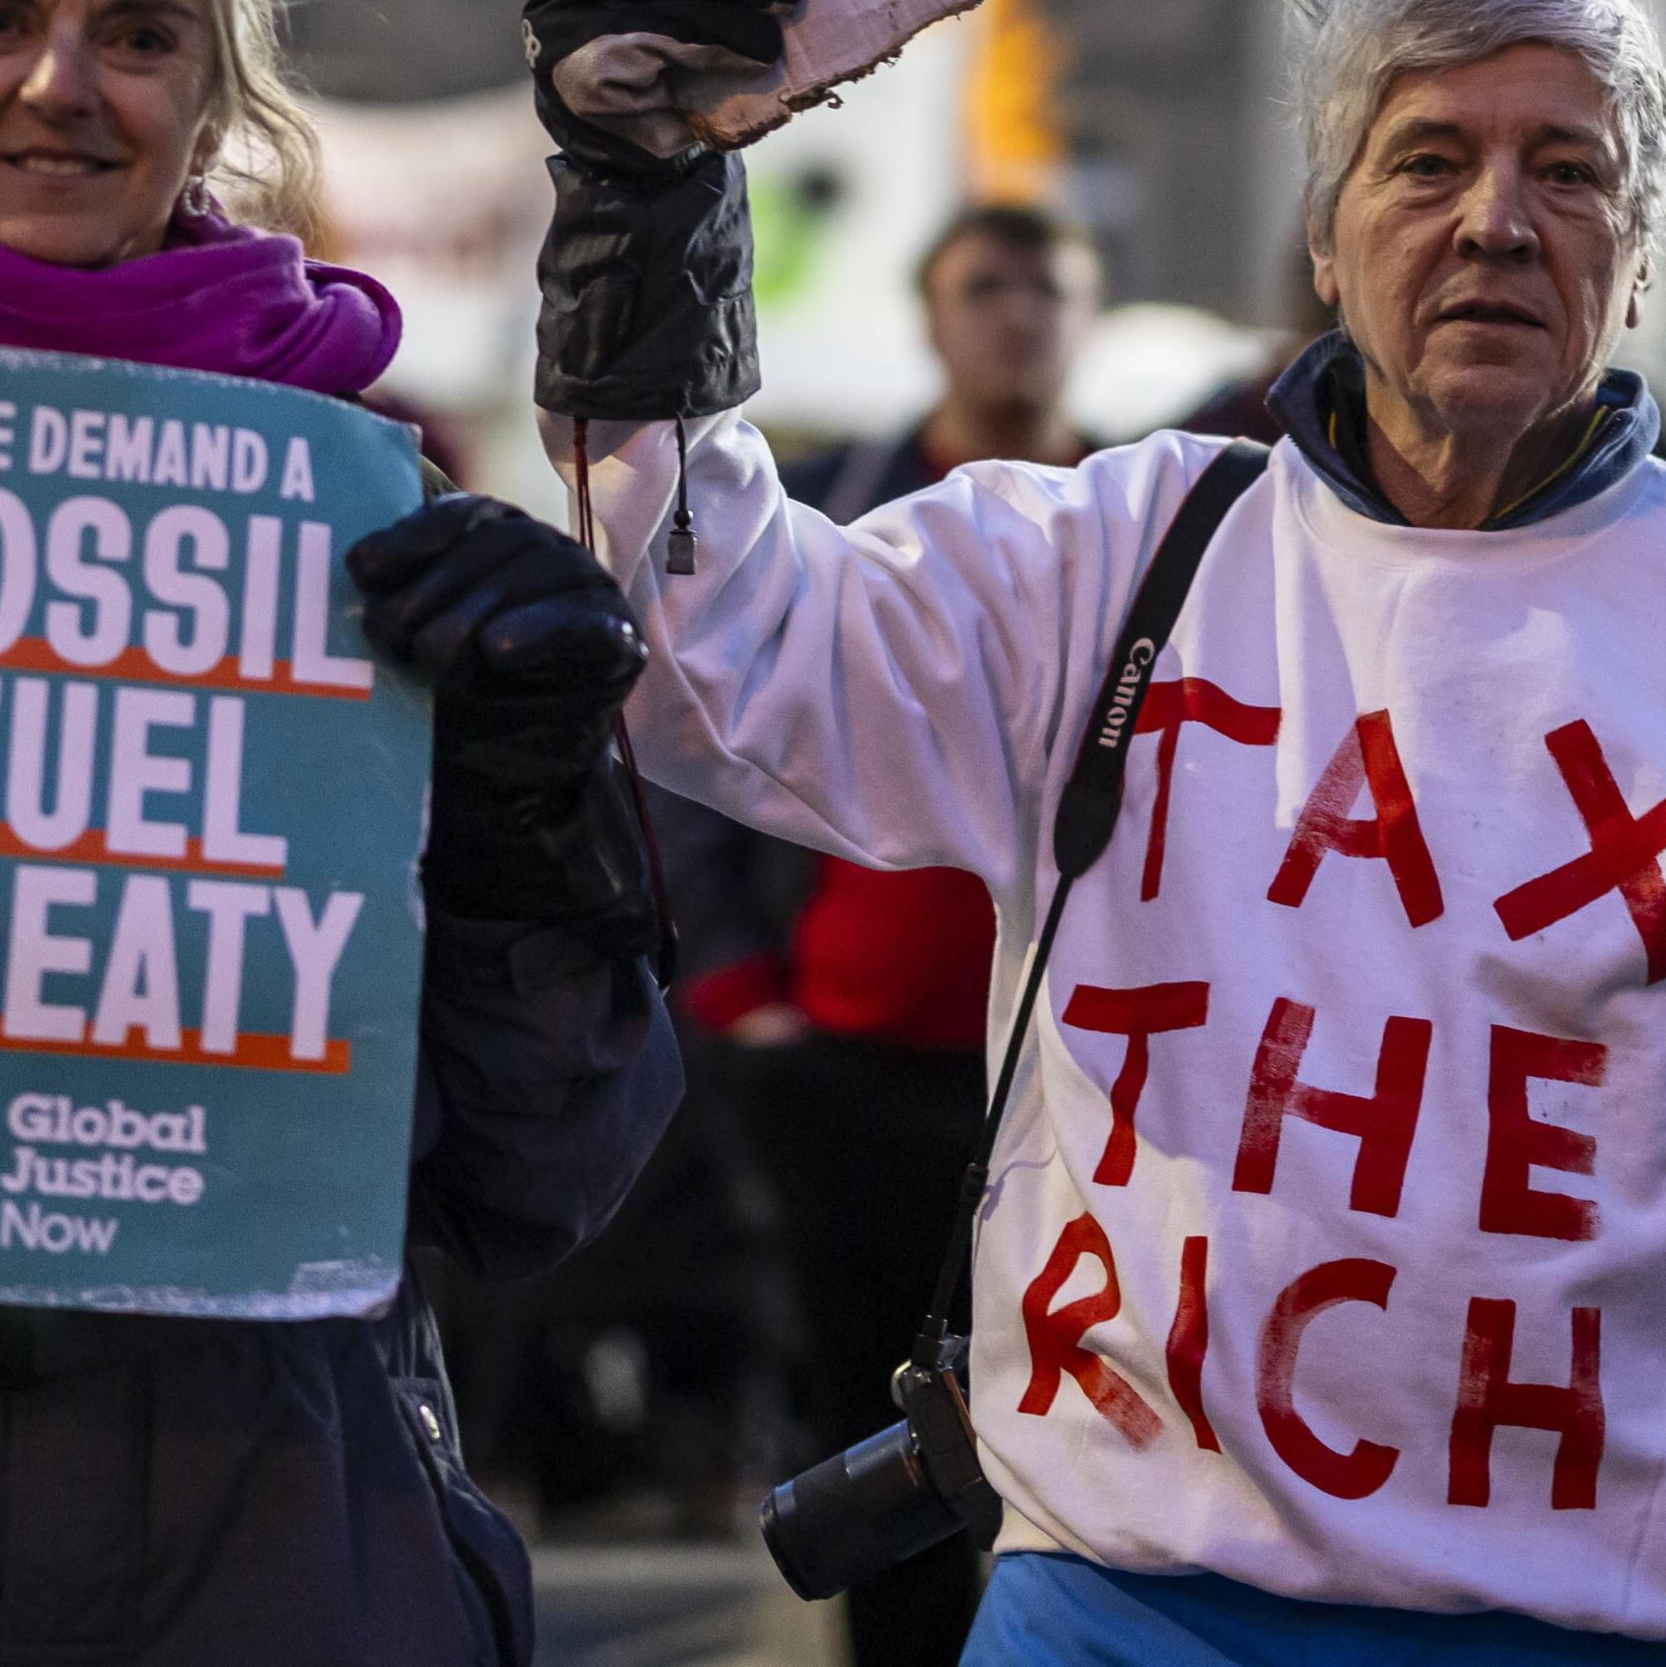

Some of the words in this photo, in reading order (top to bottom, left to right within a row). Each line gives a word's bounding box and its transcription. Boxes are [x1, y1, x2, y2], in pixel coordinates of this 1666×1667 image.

[28, 405, 269, 494] DEMAND
[280, 436, 315, 502] A
[1098, 637, 1155, 748] Canon
[7, 1092, 206, 1154] Global
[1062, 981, 1609, 1242] THE
[0, 1146, 205, 1205] Justice
[1016, 1211, 1606, 1511] RICH
